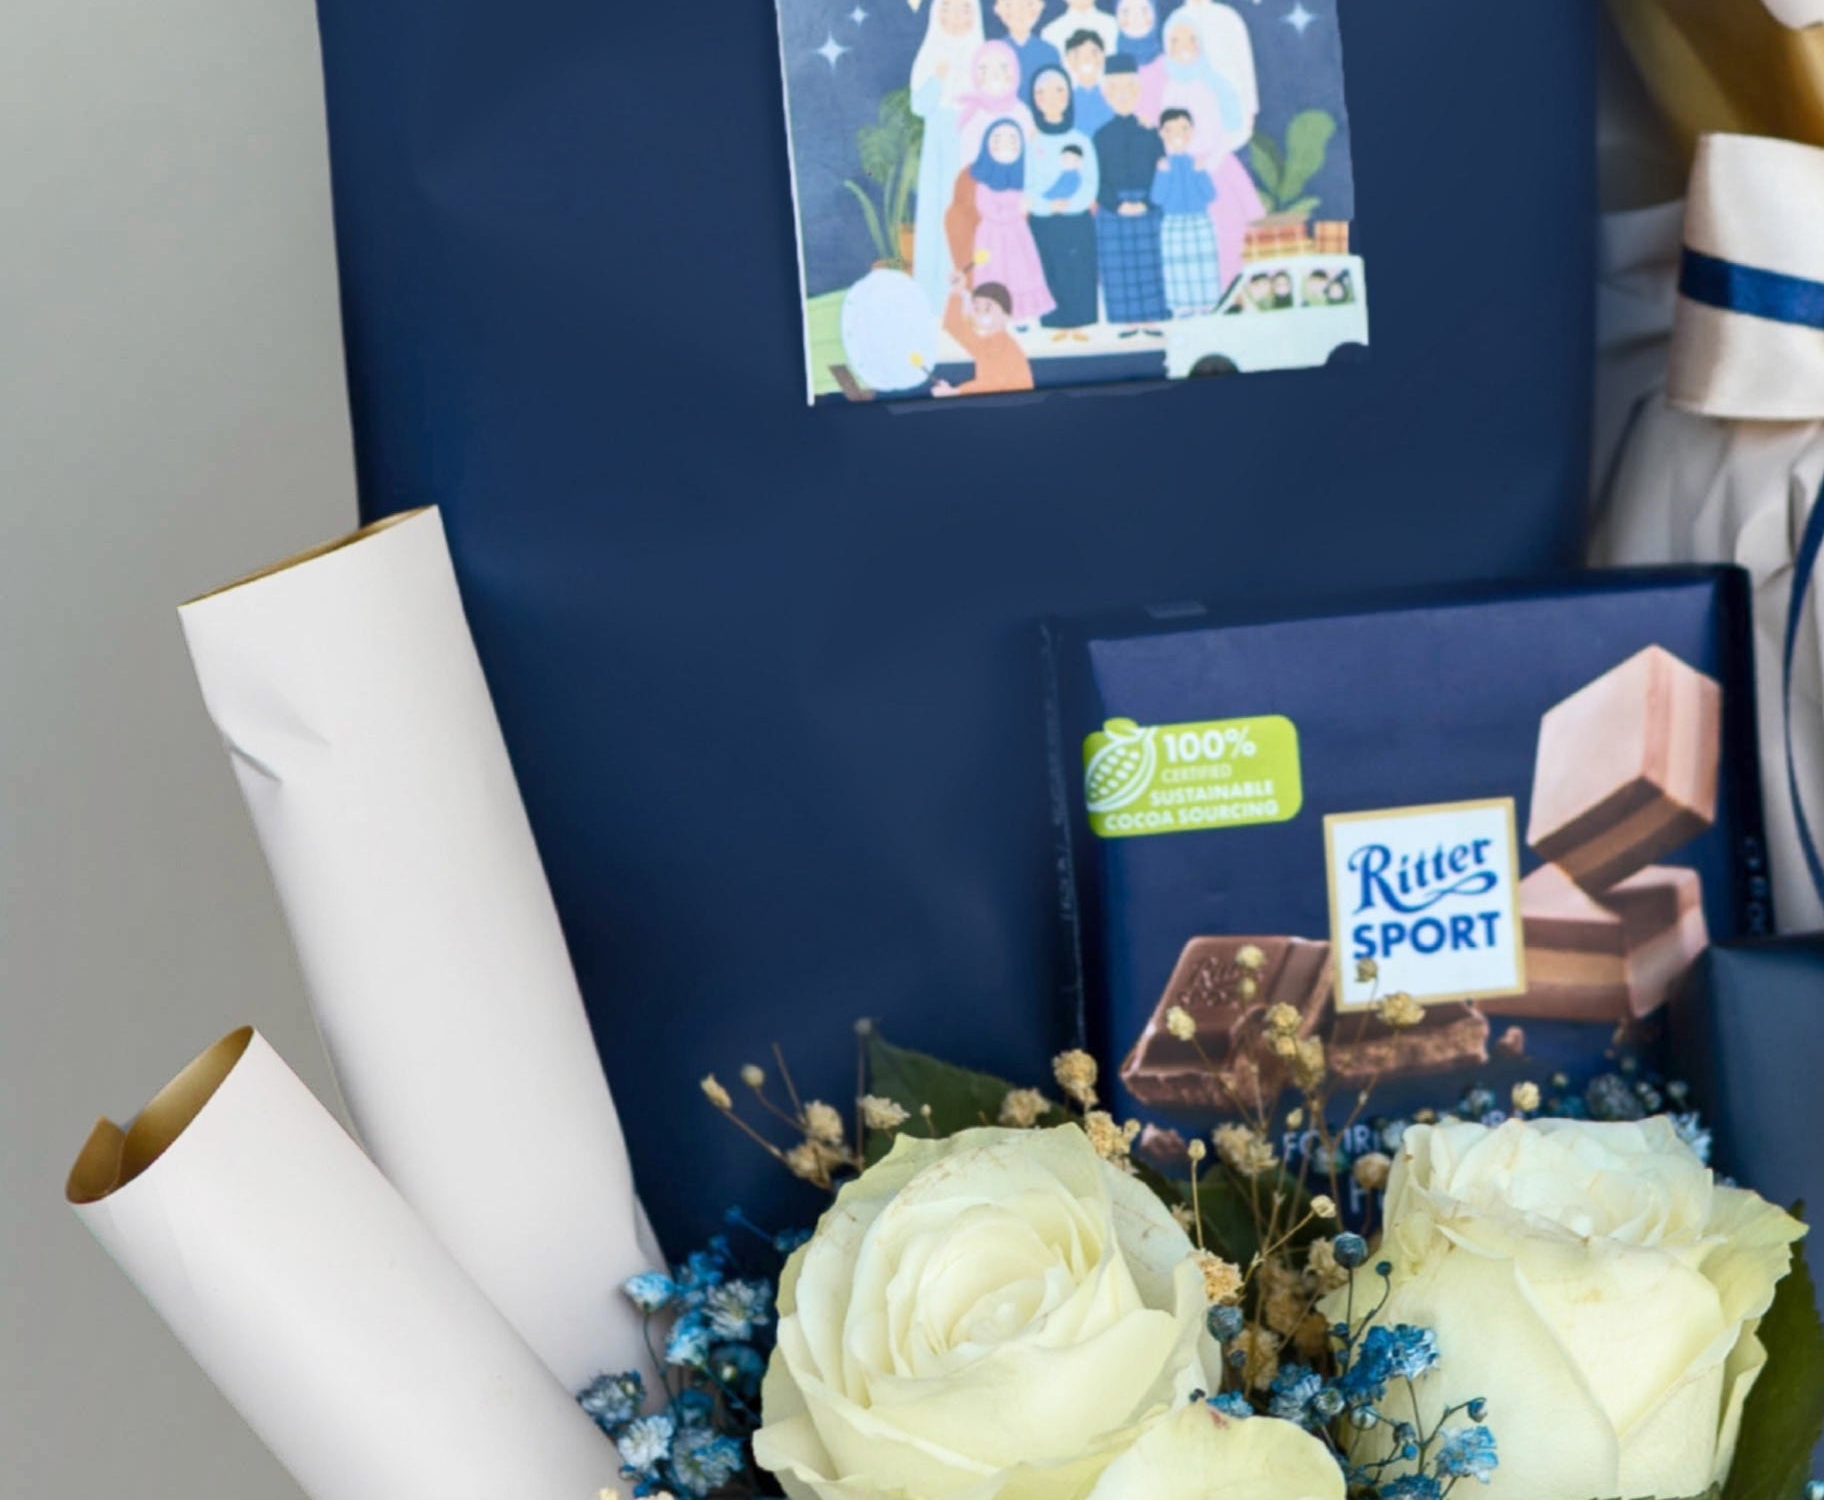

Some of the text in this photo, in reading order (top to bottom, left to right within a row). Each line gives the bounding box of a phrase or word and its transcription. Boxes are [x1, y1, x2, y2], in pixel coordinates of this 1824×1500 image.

[1162, 726, 1257, 763] 100%
[1150, 780, 1275, 807] SUSTAINABLE
[1104, 799, 1279, 831] COCOA SOURCING
[1347, 838, 1498, 915] Ritter
[1352, 910, 1501, 960] SPORT
